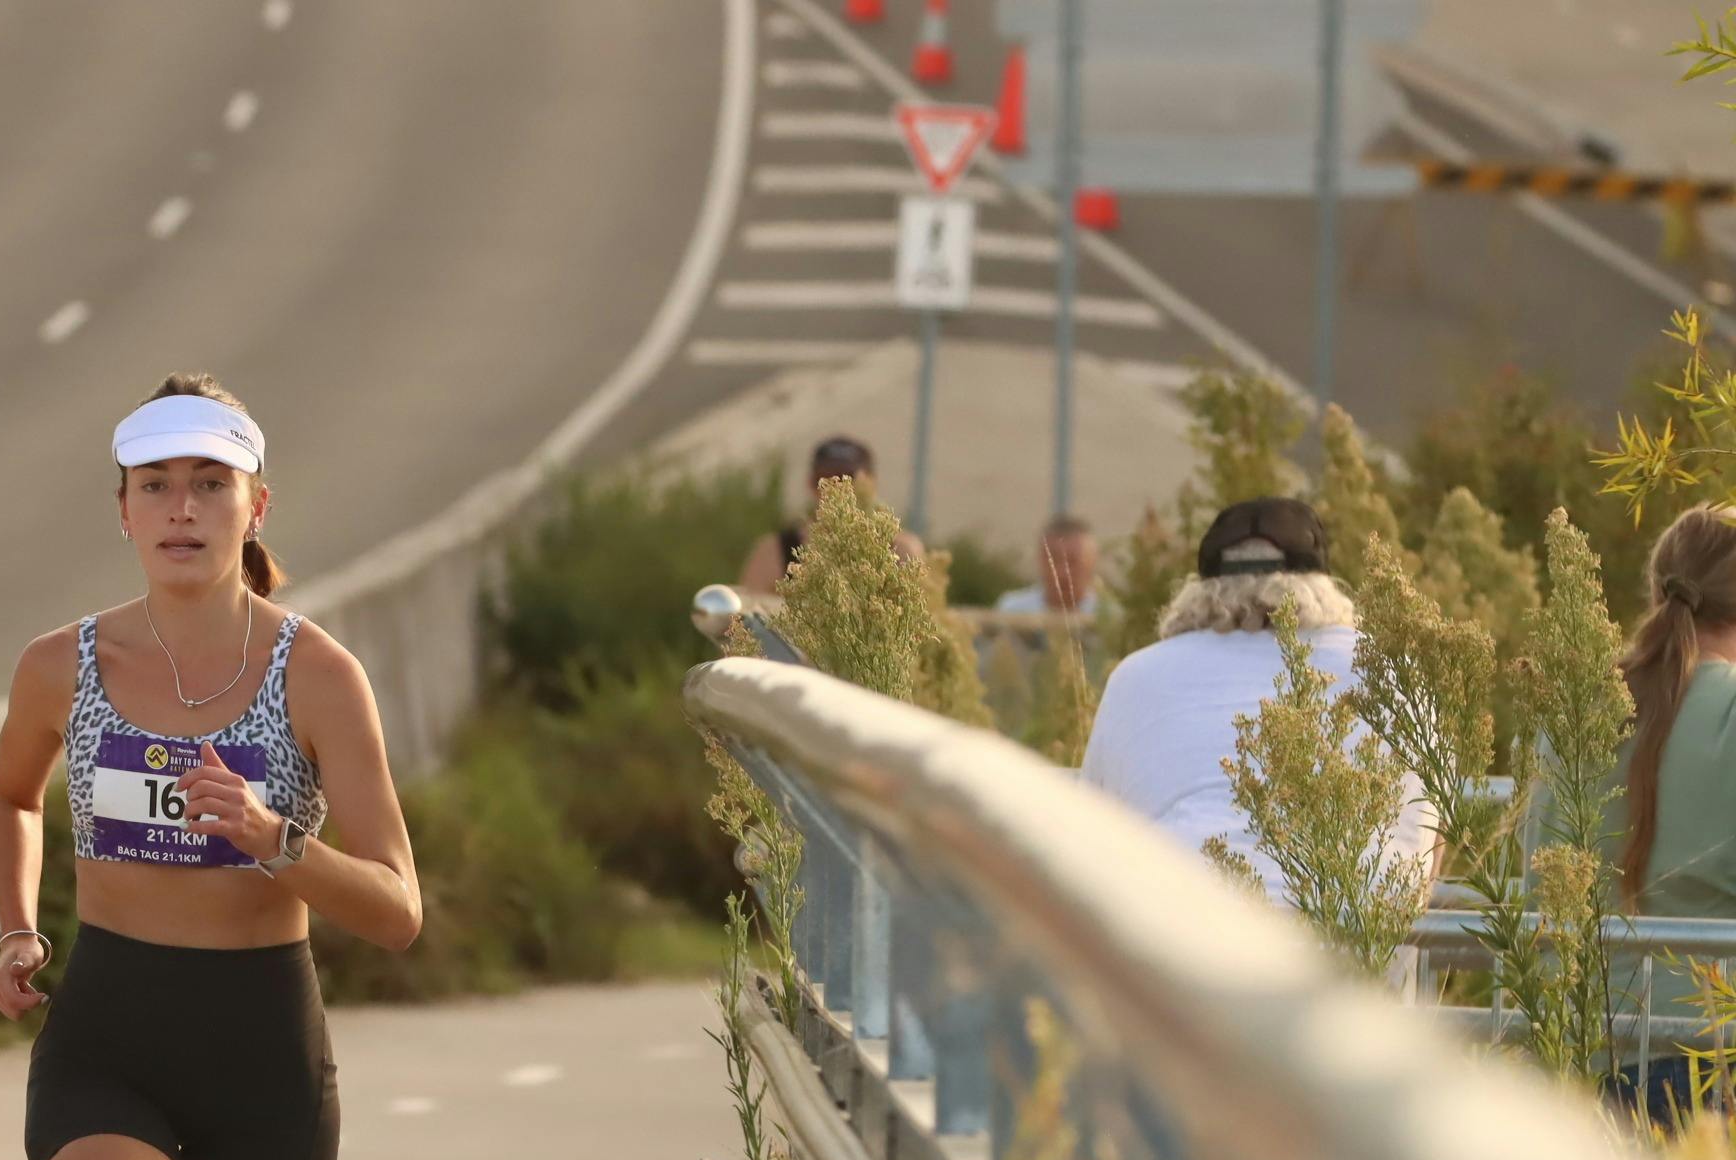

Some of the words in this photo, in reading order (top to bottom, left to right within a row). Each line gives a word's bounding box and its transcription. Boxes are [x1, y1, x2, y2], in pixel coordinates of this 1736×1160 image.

[170, 756, 182, 766] BAY
[184, 757, 191, 766] TO
[193, 758, 204, 767] BRI
[144, 779, 201, 822] 16
[147, 828, 208, 846] 21.1KM
[117, 845, 137, 857] BAG
[139, 849, 159, 860] TAG
[162, 852, 201, 863] 21.1KM
